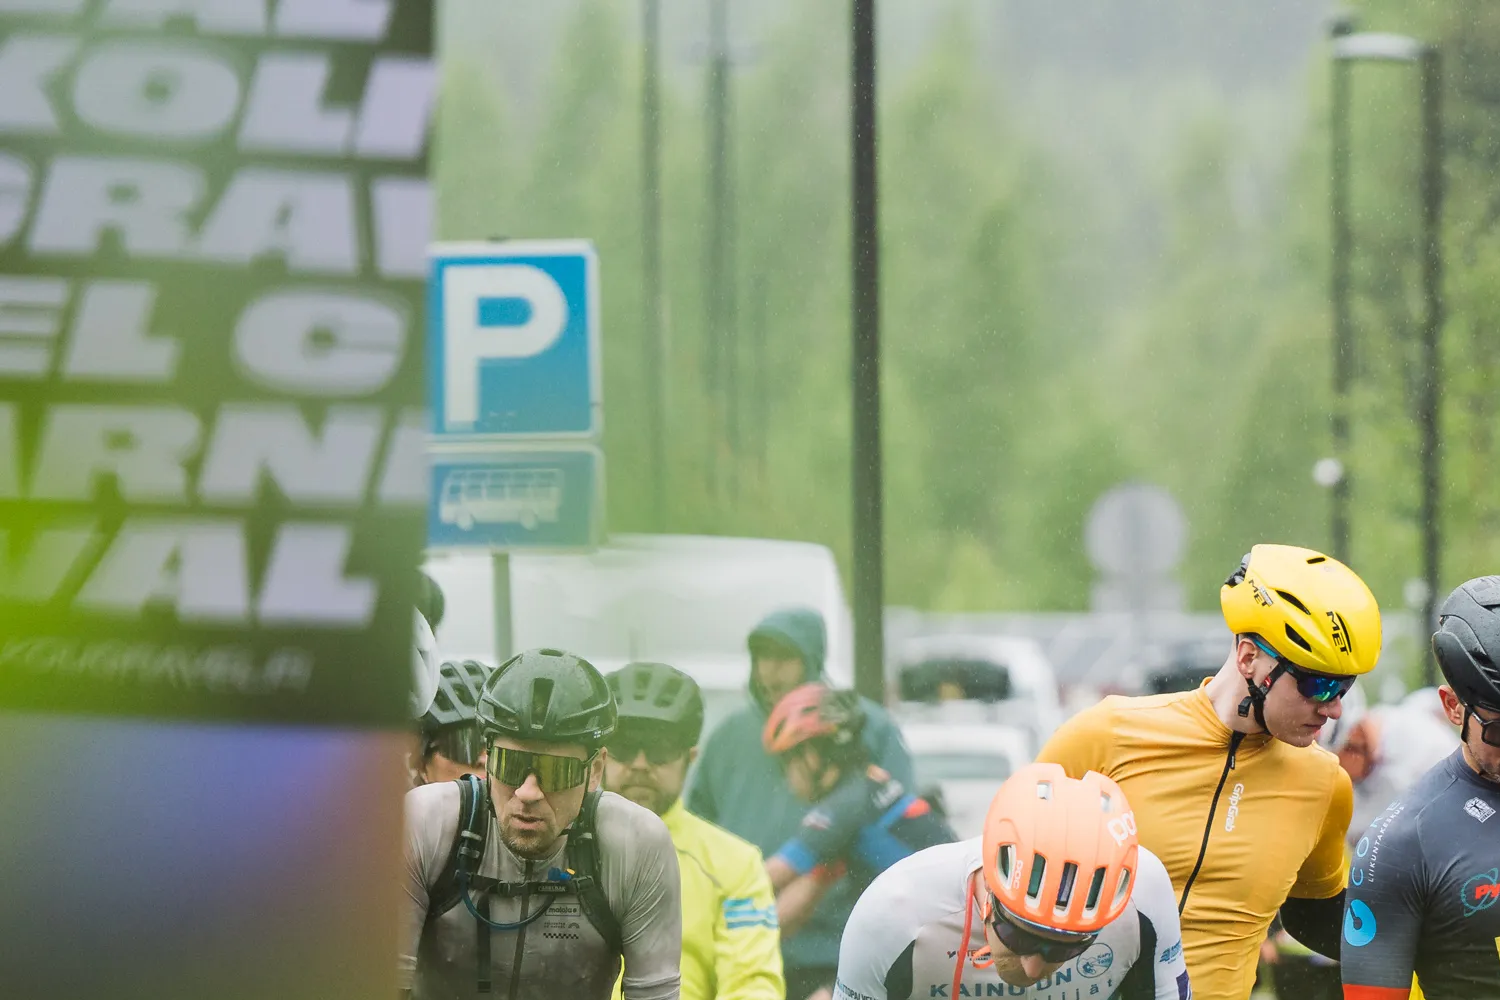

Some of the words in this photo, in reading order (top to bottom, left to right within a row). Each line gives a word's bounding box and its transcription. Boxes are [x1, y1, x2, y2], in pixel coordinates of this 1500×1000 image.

[443, 264, 567, 431] P
[1326, 611, 1349, 655] MET
[1225, 783, 1244, 832] GripGrab
